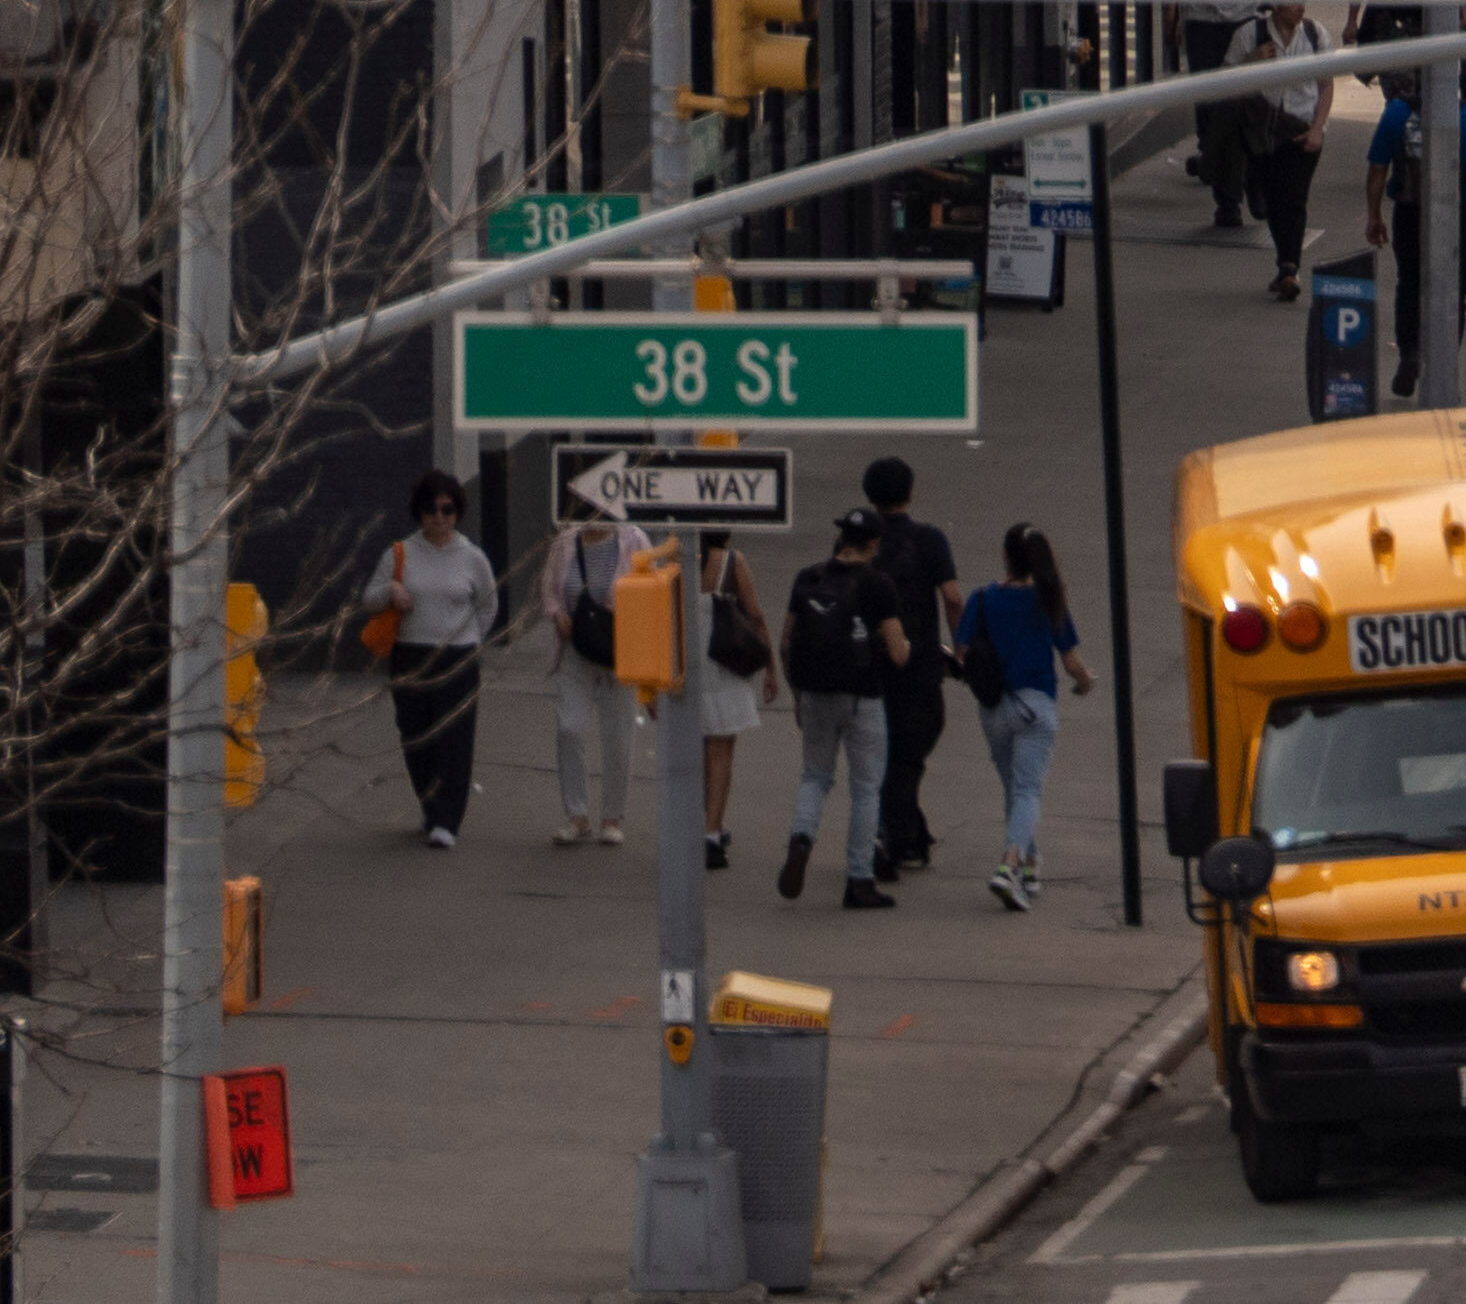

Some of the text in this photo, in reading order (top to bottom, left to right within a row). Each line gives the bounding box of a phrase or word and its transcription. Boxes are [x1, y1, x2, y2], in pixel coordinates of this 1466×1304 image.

[522, 203, 570, 247] 38
[1337, 307, 1361, 343] P
[633, 338, 799, 407] 38 St
[600, 471, 765, 503] ONE WAY
[226, 1093, 264, 1127] SE
